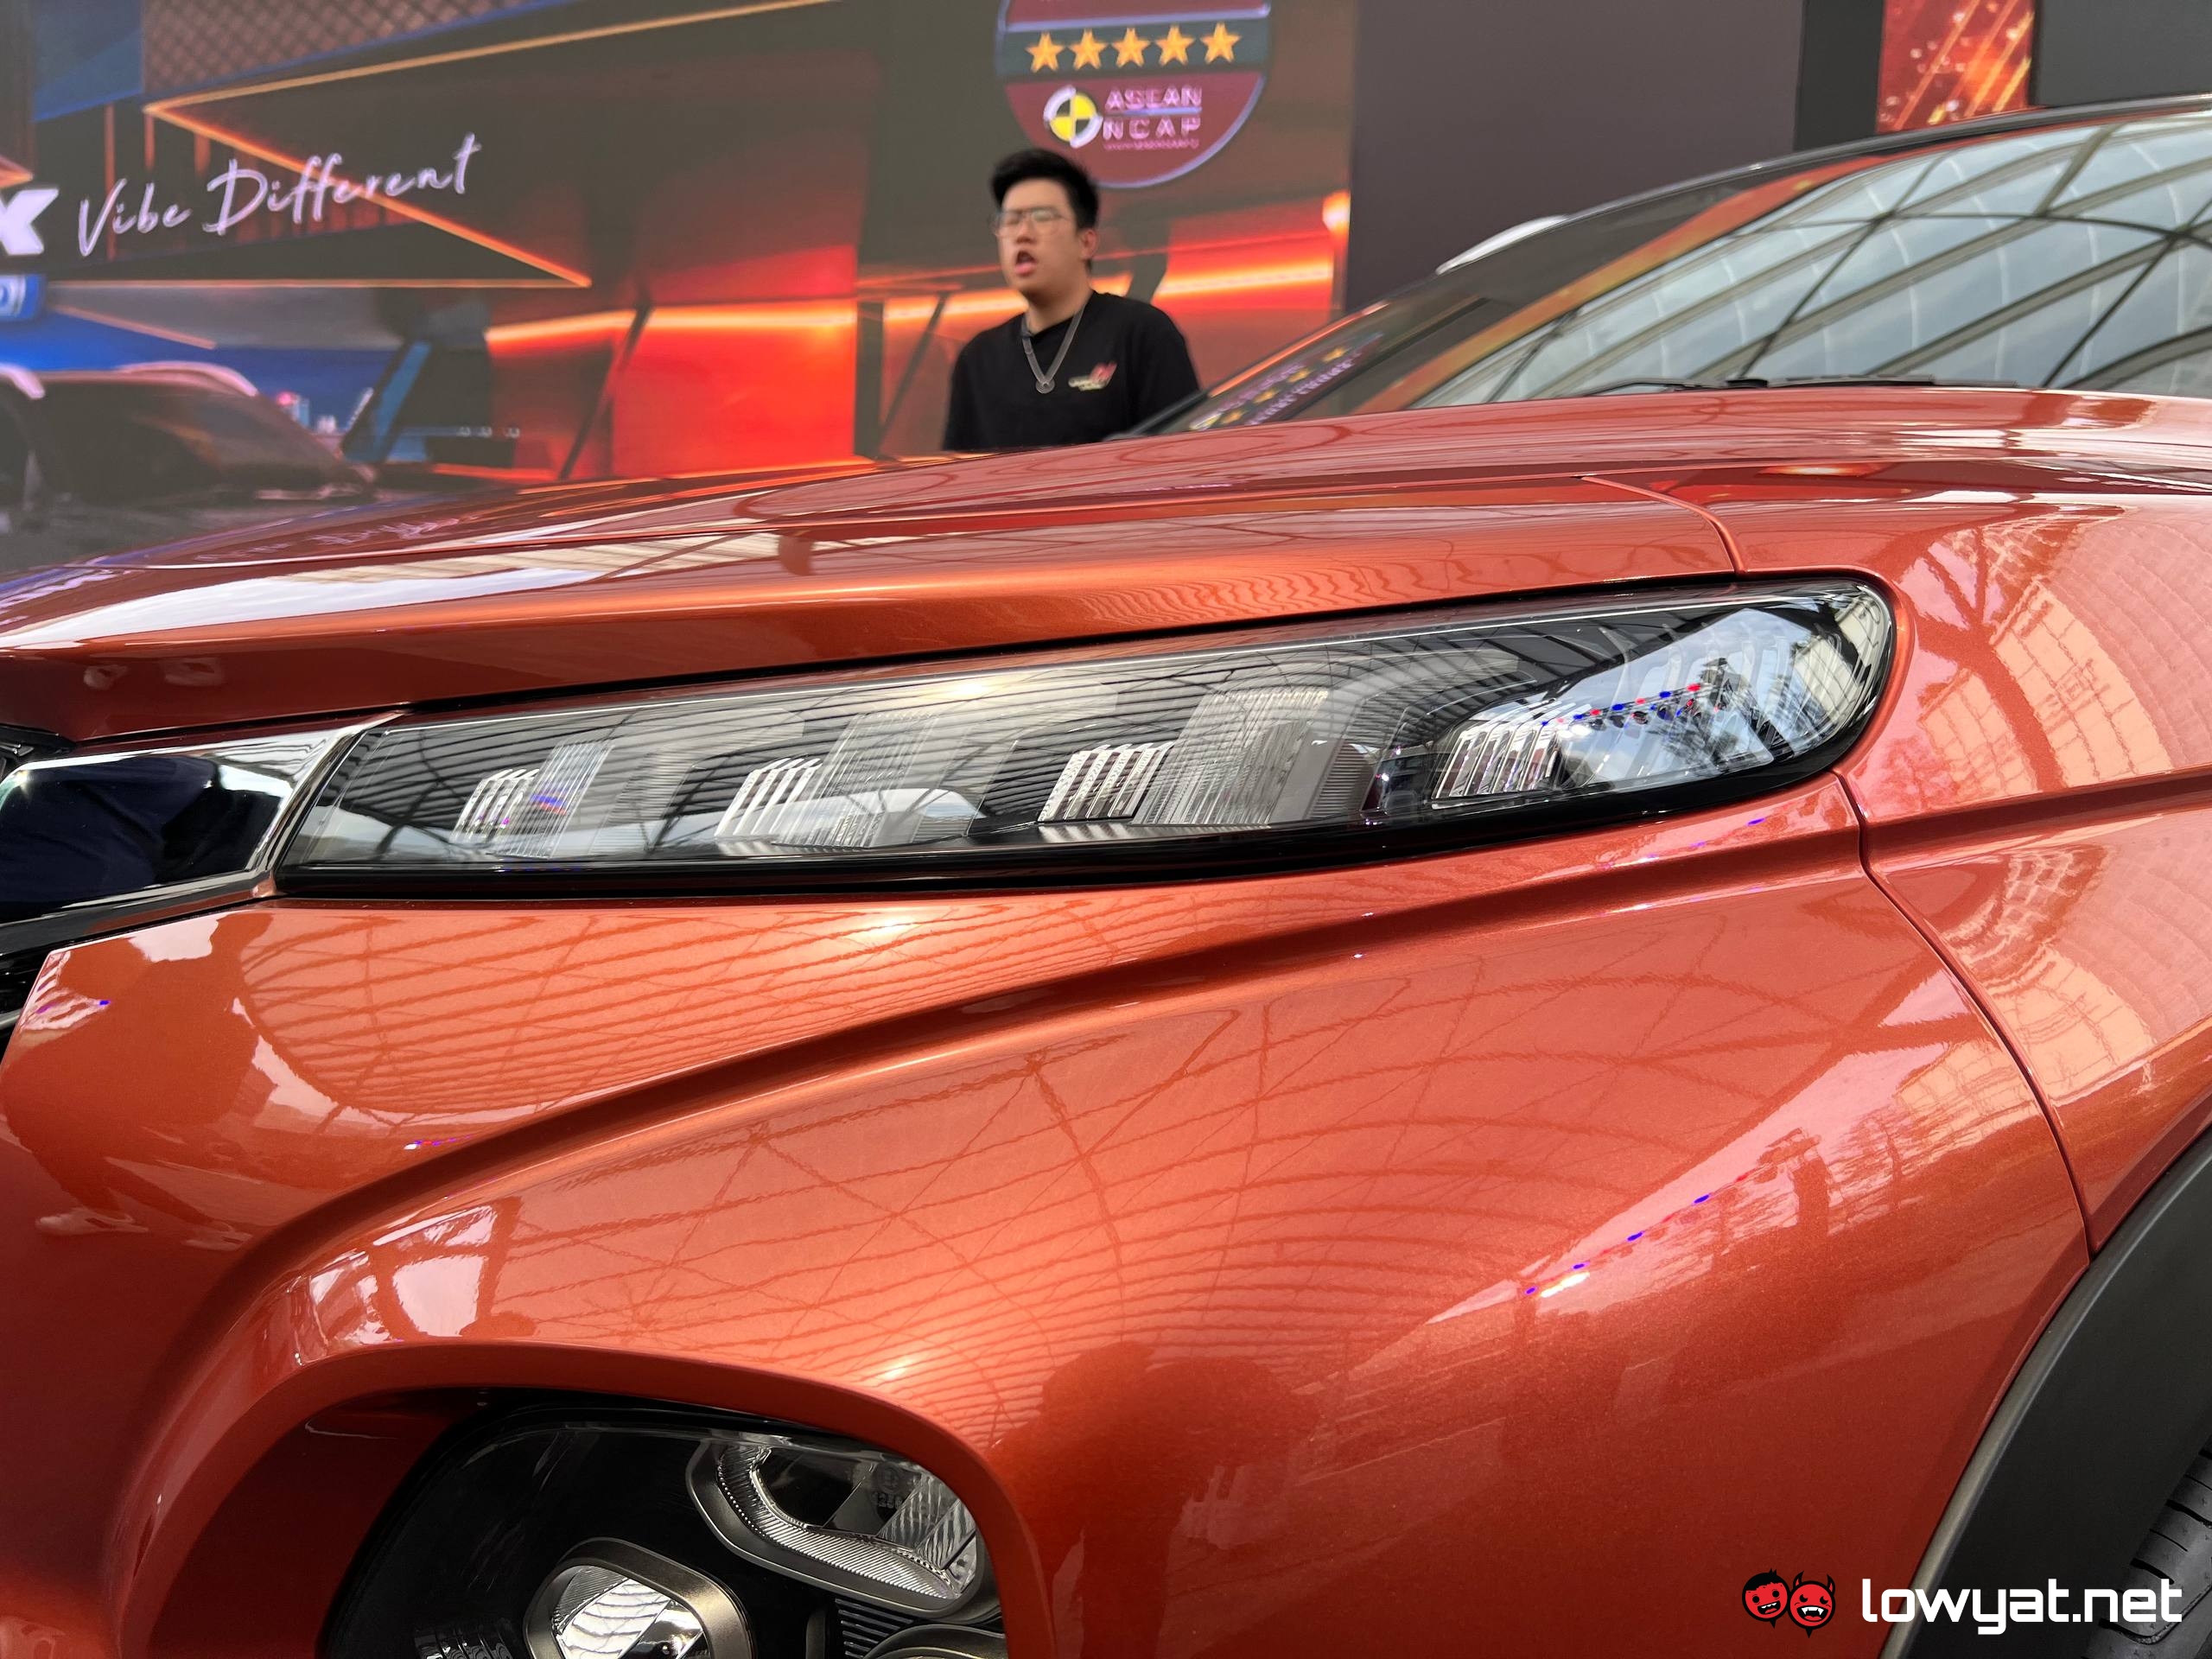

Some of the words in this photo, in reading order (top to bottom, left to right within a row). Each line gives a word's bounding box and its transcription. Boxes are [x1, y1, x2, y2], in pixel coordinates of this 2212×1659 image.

[1105, 86, 1202, 110] ASEAN
[1103, 116, 1201, 140] NCAP
[78, 178, 193, 257] Vibe
[201, 131, 481, 235] Different
